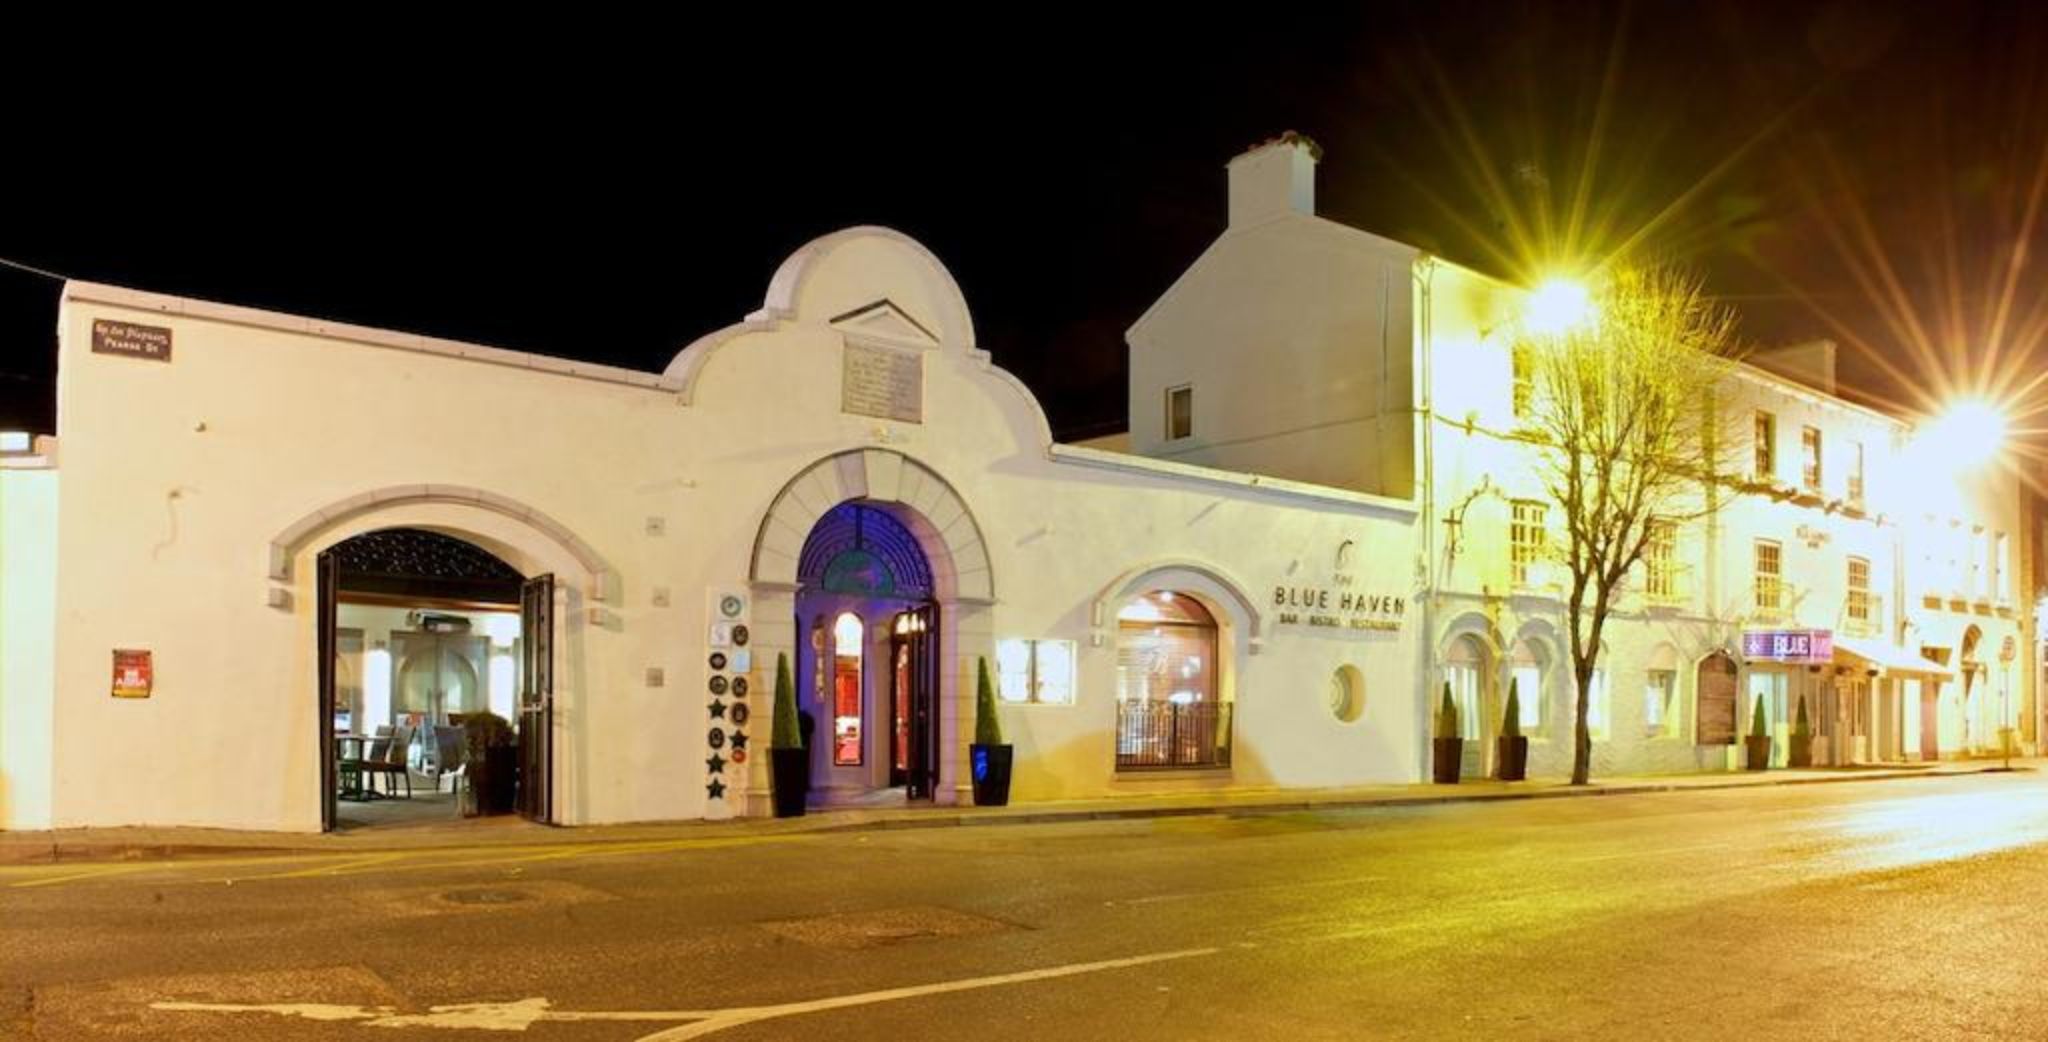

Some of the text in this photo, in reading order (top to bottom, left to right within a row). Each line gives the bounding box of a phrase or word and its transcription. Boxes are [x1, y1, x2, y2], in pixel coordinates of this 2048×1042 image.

[1274, 586, 1405, 614] BLUE HAVEN
[1279, 613, 1298, 625] BAR
[1774, 635, 1809, 655] BLUE
